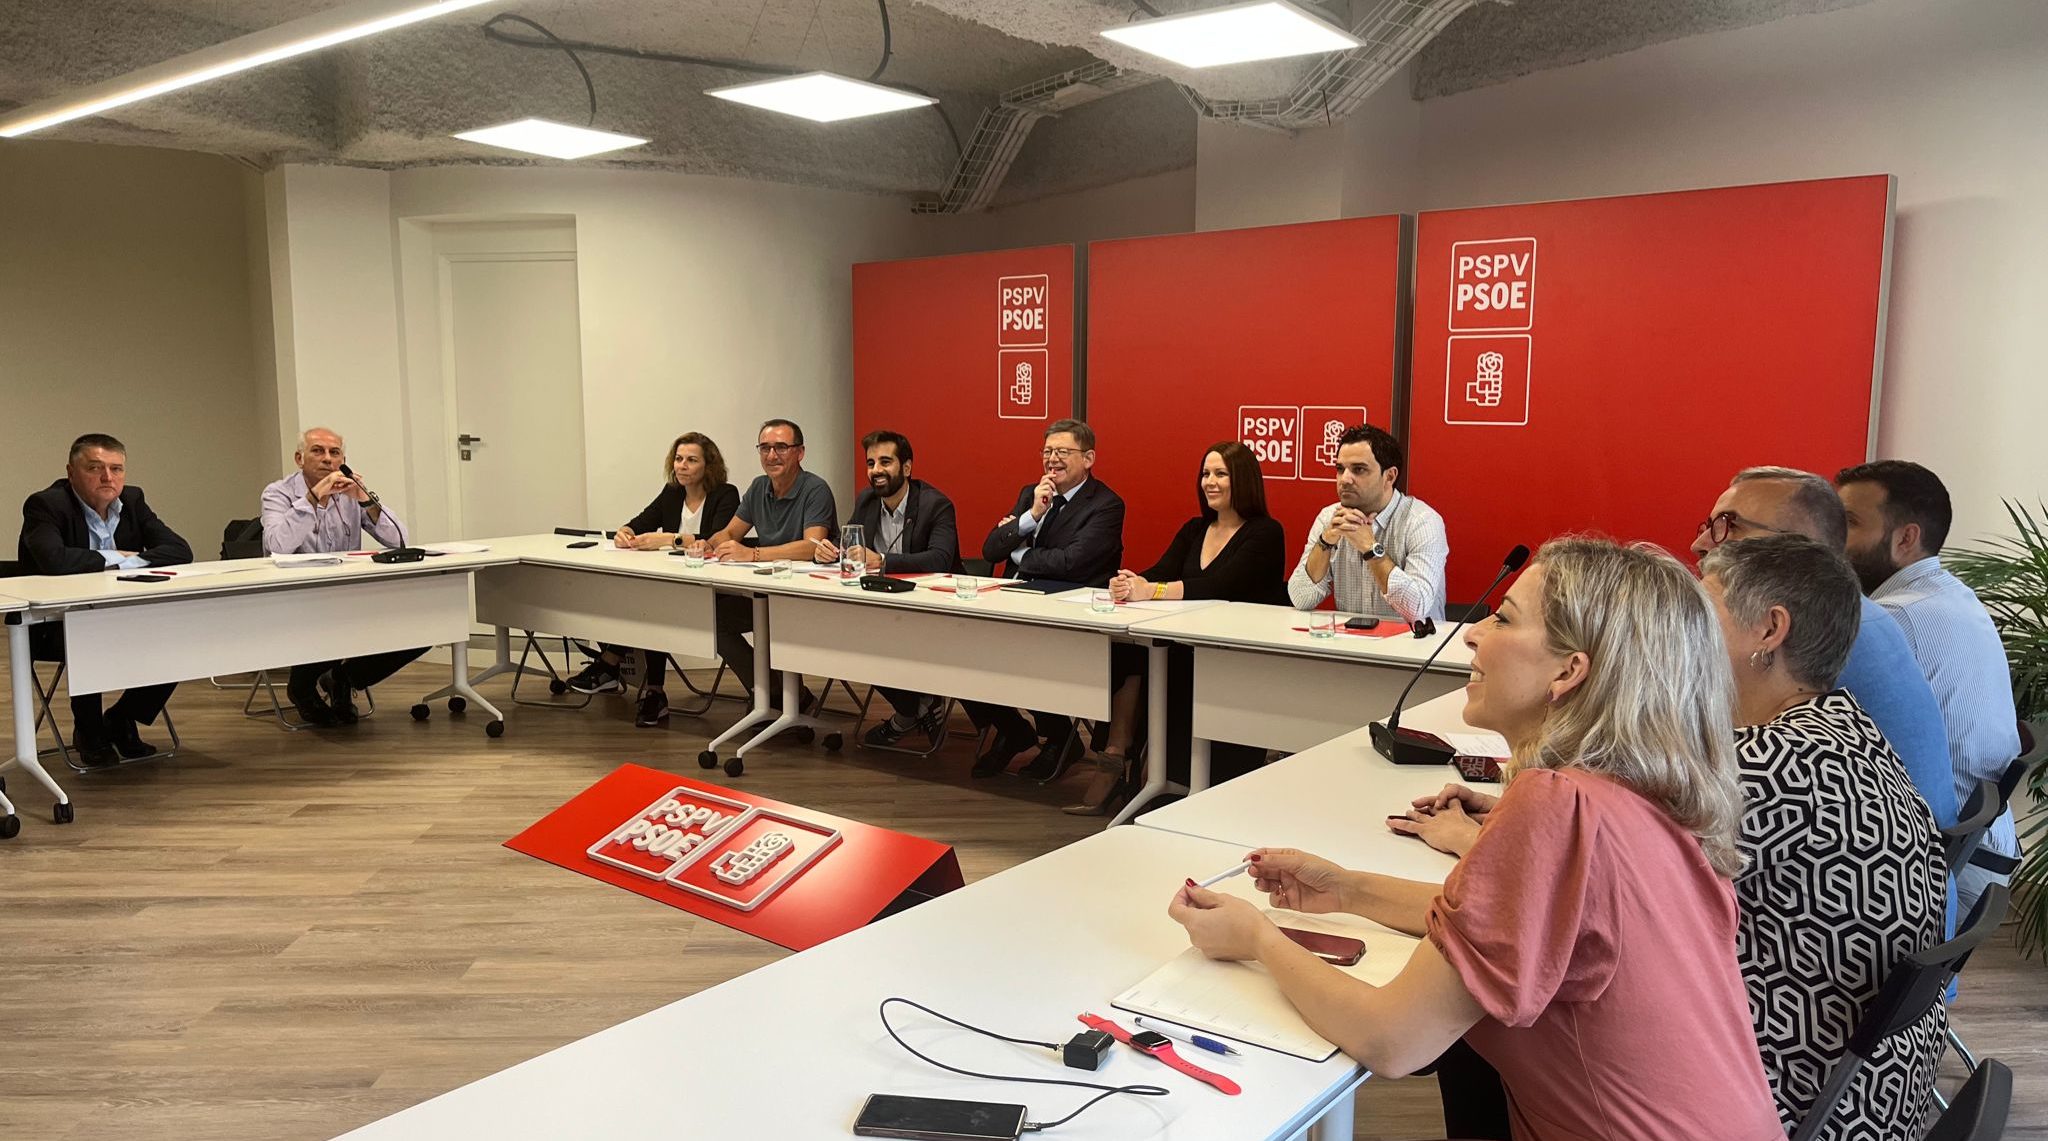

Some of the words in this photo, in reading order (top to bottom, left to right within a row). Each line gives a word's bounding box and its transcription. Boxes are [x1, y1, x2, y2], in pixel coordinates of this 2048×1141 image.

[1458, 252, 1530, 279] PSPV
[1002, 285, 1045, 306] PSPV
[1456, 280, 1527, 311] PSOE
[1002, 307, 1044, 331] PSOE
[1243, 417, 1295, 437] PSPV
[649, 799, 734, 836] PSPV
[614, 818, 704, 862] PSOE
